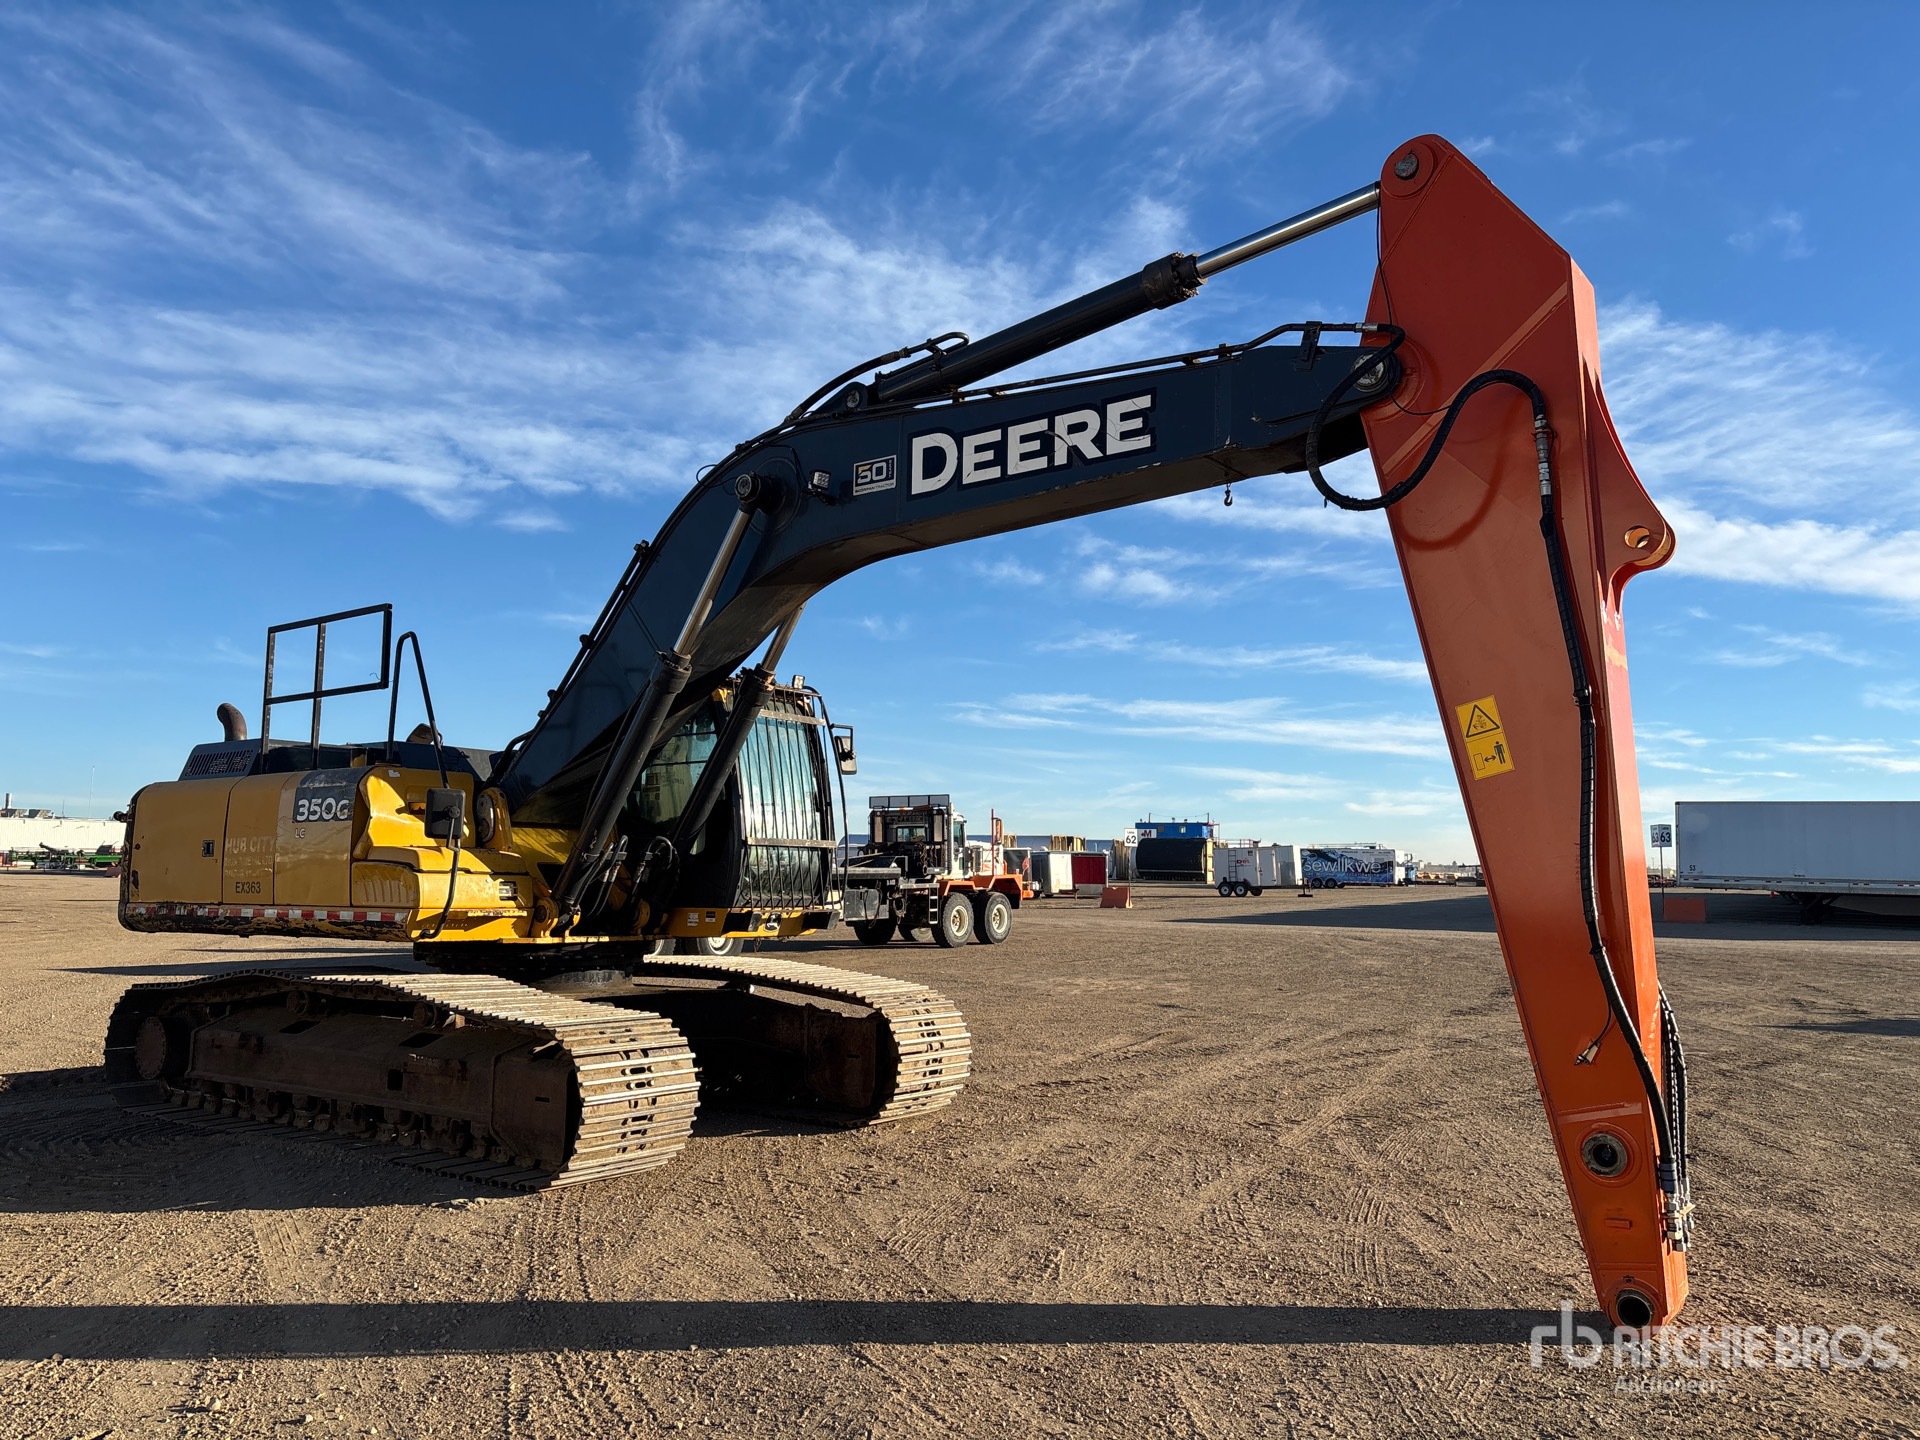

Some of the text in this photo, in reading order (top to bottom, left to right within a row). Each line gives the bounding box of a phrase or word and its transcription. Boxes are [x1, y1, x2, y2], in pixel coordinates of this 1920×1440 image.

[911, 394, 1152, 495] DEERE
[857, 461, 887, 484] 50
[296, 797, 350, 821] 350G
[1125, 835, 1137, 844] 62
[1660, 832, 1671, 843] 63
[235, 881, 262, 894] EX363
